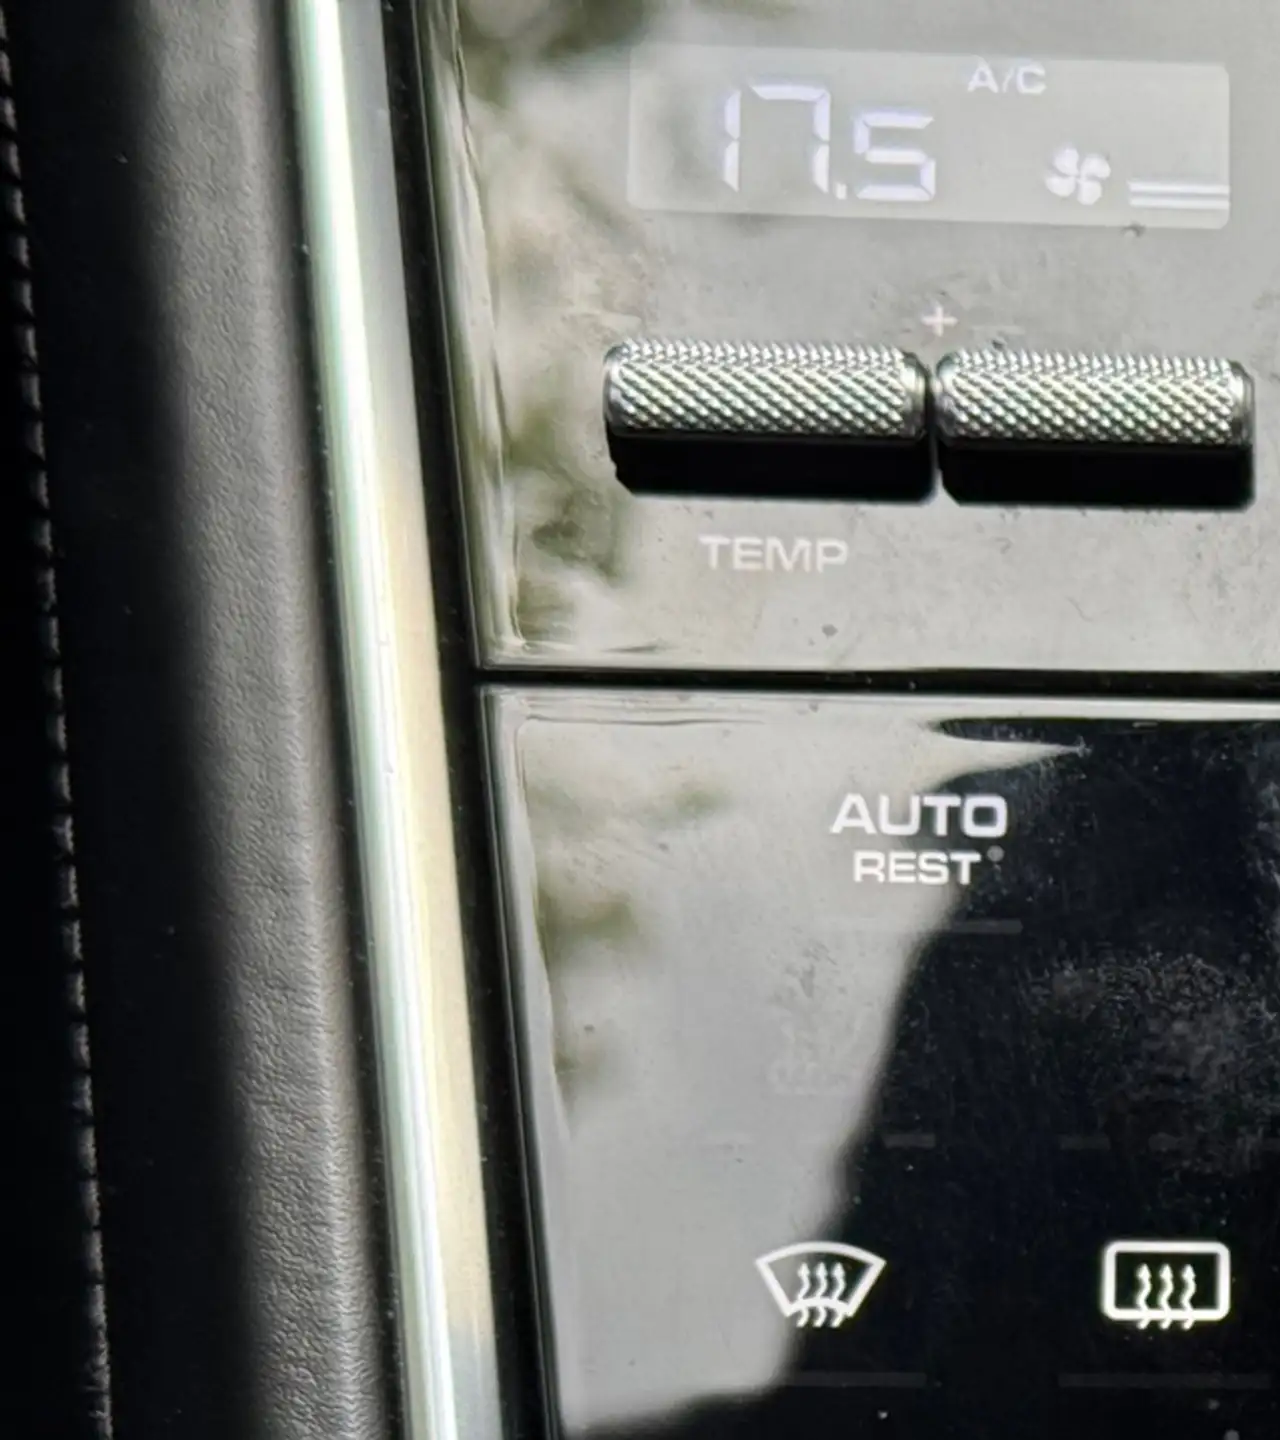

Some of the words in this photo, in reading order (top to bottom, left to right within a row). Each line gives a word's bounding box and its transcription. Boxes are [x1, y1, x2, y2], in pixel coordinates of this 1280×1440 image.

[967, 62, 1047, 96] A/C
[722, 84, 936, 201] 17.5
[698, 534, 849, 573] TEMP
[830, 794, 1008, 837] AUTO
[853, 850, 981, 885] REST
